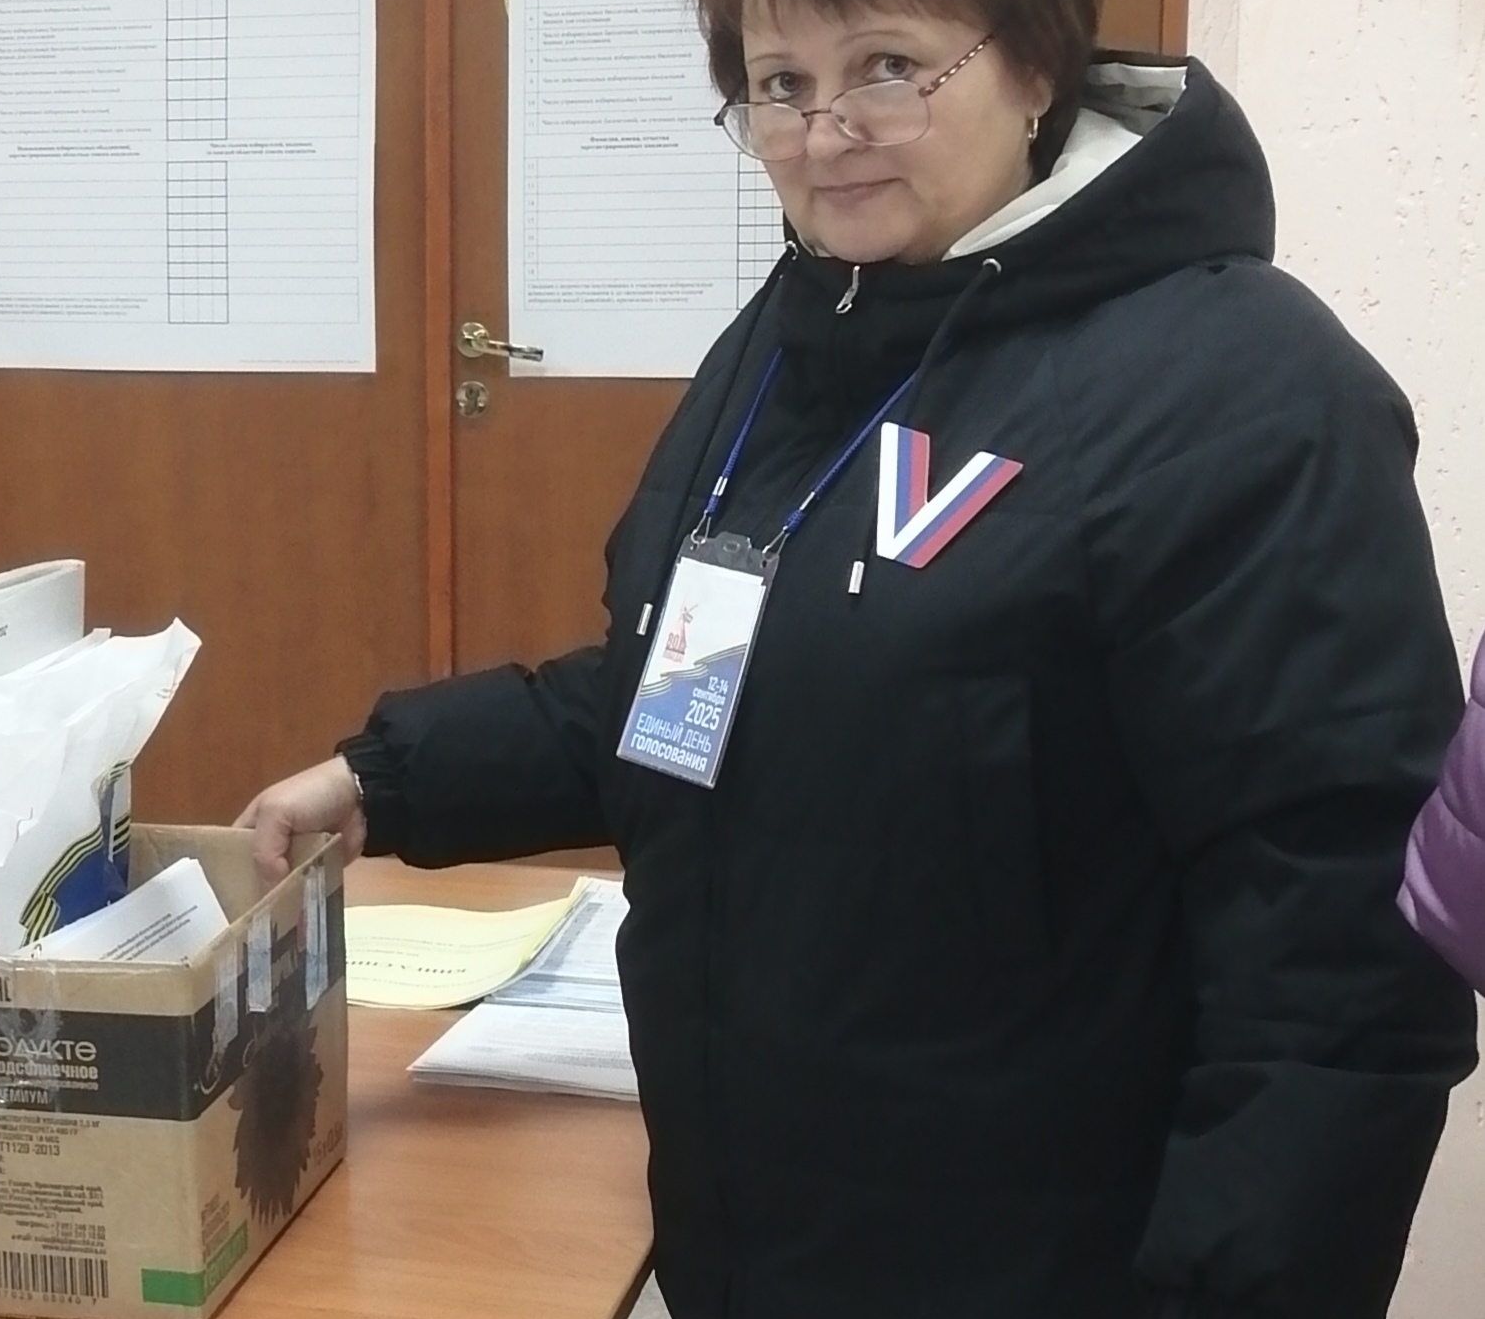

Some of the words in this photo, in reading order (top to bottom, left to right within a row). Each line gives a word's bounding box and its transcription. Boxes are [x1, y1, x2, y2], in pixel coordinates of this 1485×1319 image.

[707, 676, 729, 694] 12-14
[684, 699, 722, 731] 2025
[636, 712, 684, 744] ЕДИНЫЙ
[681, 728, 712, 754] ДЕНЬ
